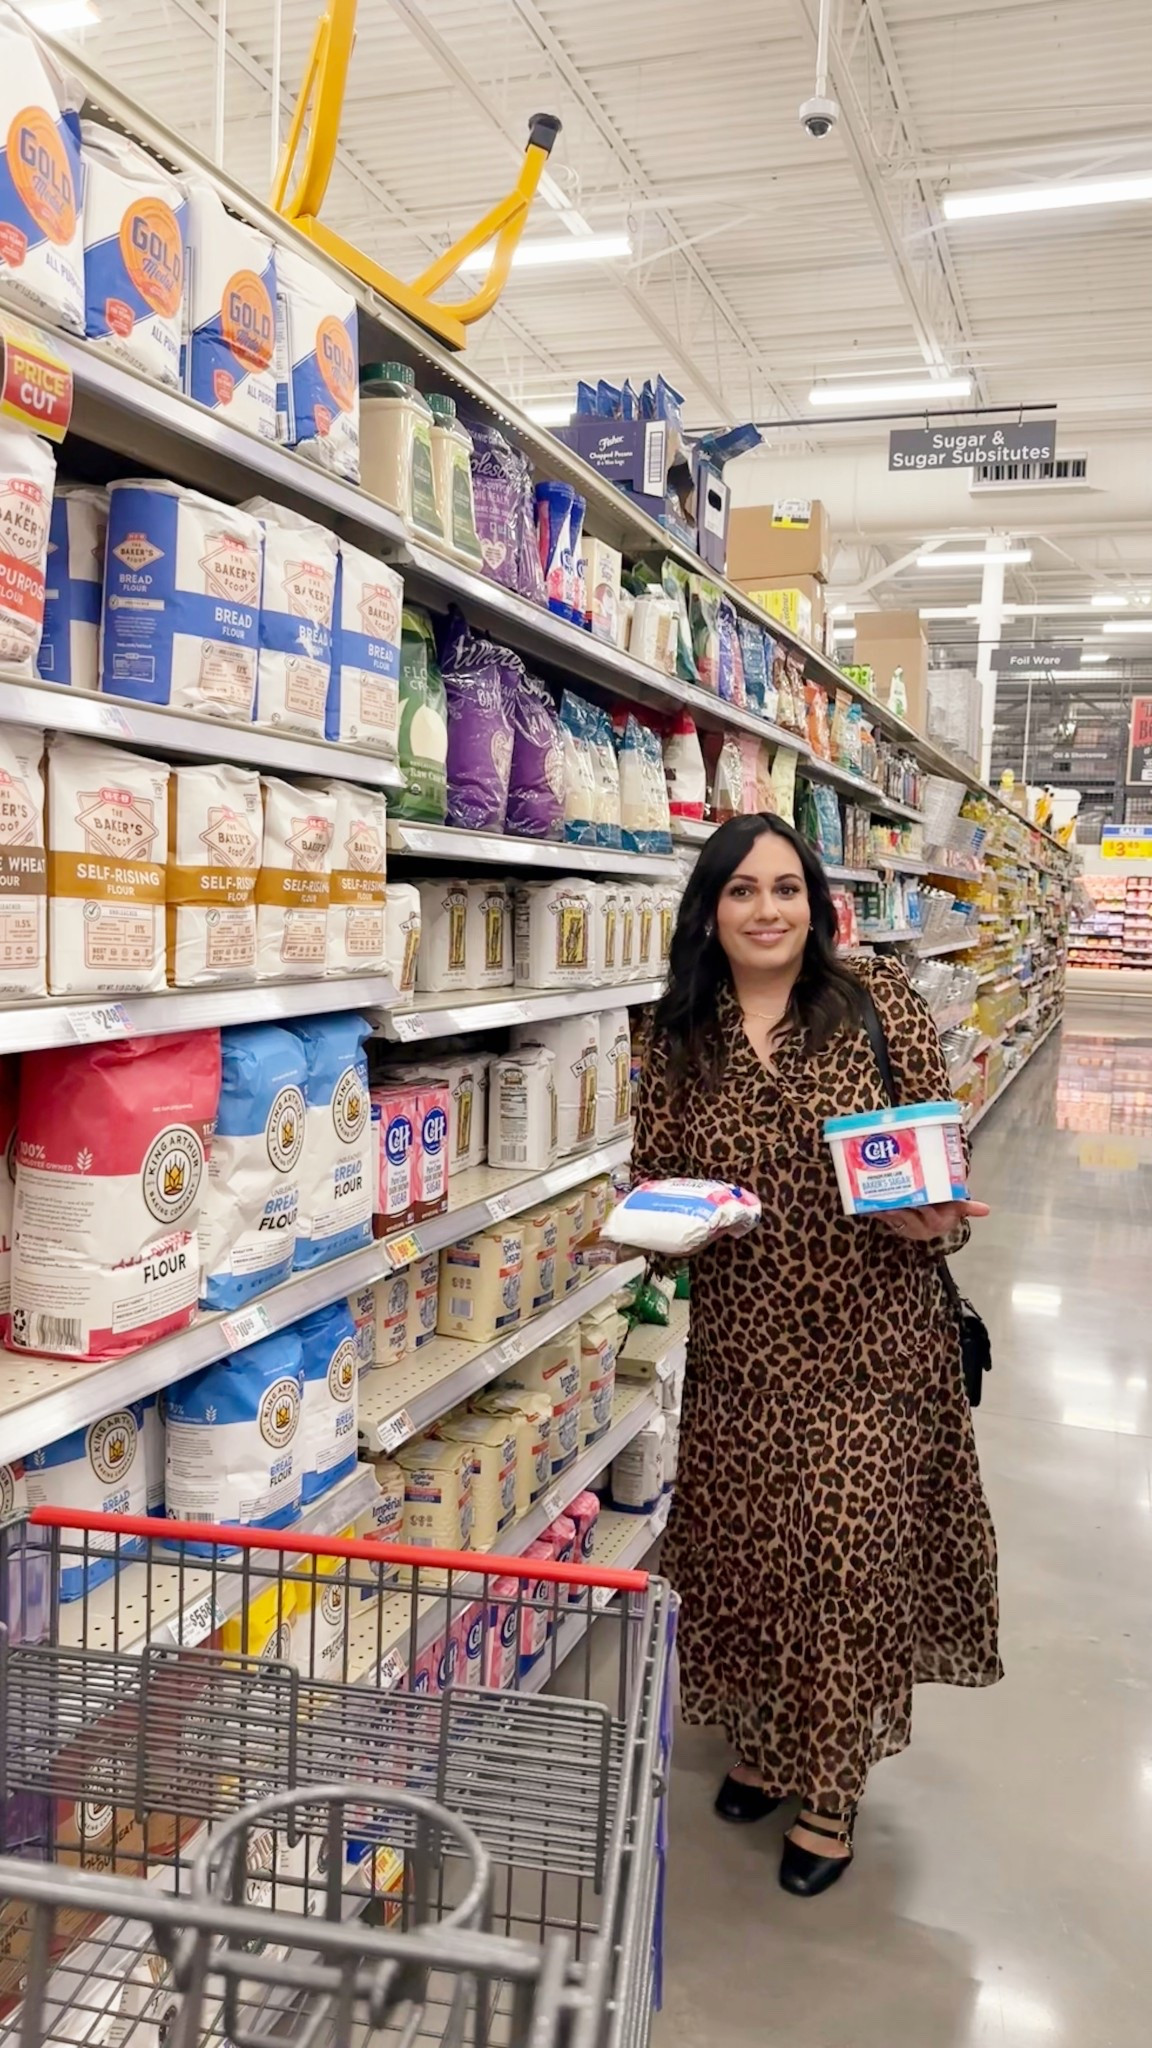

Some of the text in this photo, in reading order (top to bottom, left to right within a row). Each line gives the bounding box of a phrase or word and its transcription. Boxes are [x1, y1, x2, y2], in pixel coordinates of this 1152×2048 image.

[20, 127, 72, 205] GOLD
[132, 216, 181, 281] GOLD
[45, 252, 59, 274] ALL
[142, 257, 175, 293] Medal
[230, 292, 271, 340] GOLD
[151, 325, 163, 345] ALL
[322, 333, 354, 379] GOLD
[14, 354, 66, 397] PRICE
[20, 382, 57, 415] CUT
[247, 384, 258, 400] ALL
[932, 430, 1005, 451] Sugar &
[892, 445, 1051, 469] Sugar Subsitutes
[120, 546, 154, 556] BAKER'S
[230, 554, 243, 565] THE
[119, 574, 153, 585] BREAD
[214, 562, 256, 583] BAKER'S
[122, 584, 148, 592] FLOUR
[224, 578, 249, 592] SCOOP
[214, 607, 253, 628] BREAD
[368, 605, 395, 625] BAKER'S
[222, 625, 245, 640] FLOUR
[368, 643, 394, 662] BREAD
[1009, 655, 1061, 666] Foil Ware
[373, 659, 390, 671] FLOUR
[103, 790, 130, 804] H-E-B
[112, 808, 123, 818] THE
[93, 817, 144, 837] BAKER'S
[107, 835, 132, 847] SCOOP
[218, 834, 251, 846] BAKER'S
[76, 862, 160, 886] SELF-RISING
[107, 884, 136, 897] FLOUR
[92, 947, 107, 955] BEST
[337, 1077, 351, 1106] KING
[271, 1103, 283, 1133] KING
[388, 1123, 411, 1154] C&H
[423, 1115, 446, 1144] C&H
[19, 1141, 46, 1160] 100%
[148, 1135, 200, 1176] KING ARTHUR
[864, 1140, 896, 1160] C&H
[46, 1162, 74, 1172] OWNED
[334, 1159, 362, 1183] BREAD
[334, 1176, 362, 1200] FLOUR
[426, 1180, 441, 1194] SUGAR
[862, 1180, 888, 1191] BAKER'S
[888, 1176, 911, 1188] SUGAR
[149, 1183, 197, 1216] BAKING COMPANY
[264, 1189, 299, 1214] BREAD
[391, 1192, 407, 1208] SUGAR
[258, 1207, 298, 1231] FLOUR
[144, 1253, 187, 1284] FLOUR
[332, 1353, 342, 1375] KING
[262, 1391, 278, 1418] KING
[94, 1425, 107, 1454] KING
[269, 1456, 294, 1477] BREAD
[269, 1467, 293, 1488] FLOUR
[102, 1489, 131, 1513] BREAD
[376, 1510, 398, 1527] Sugar
